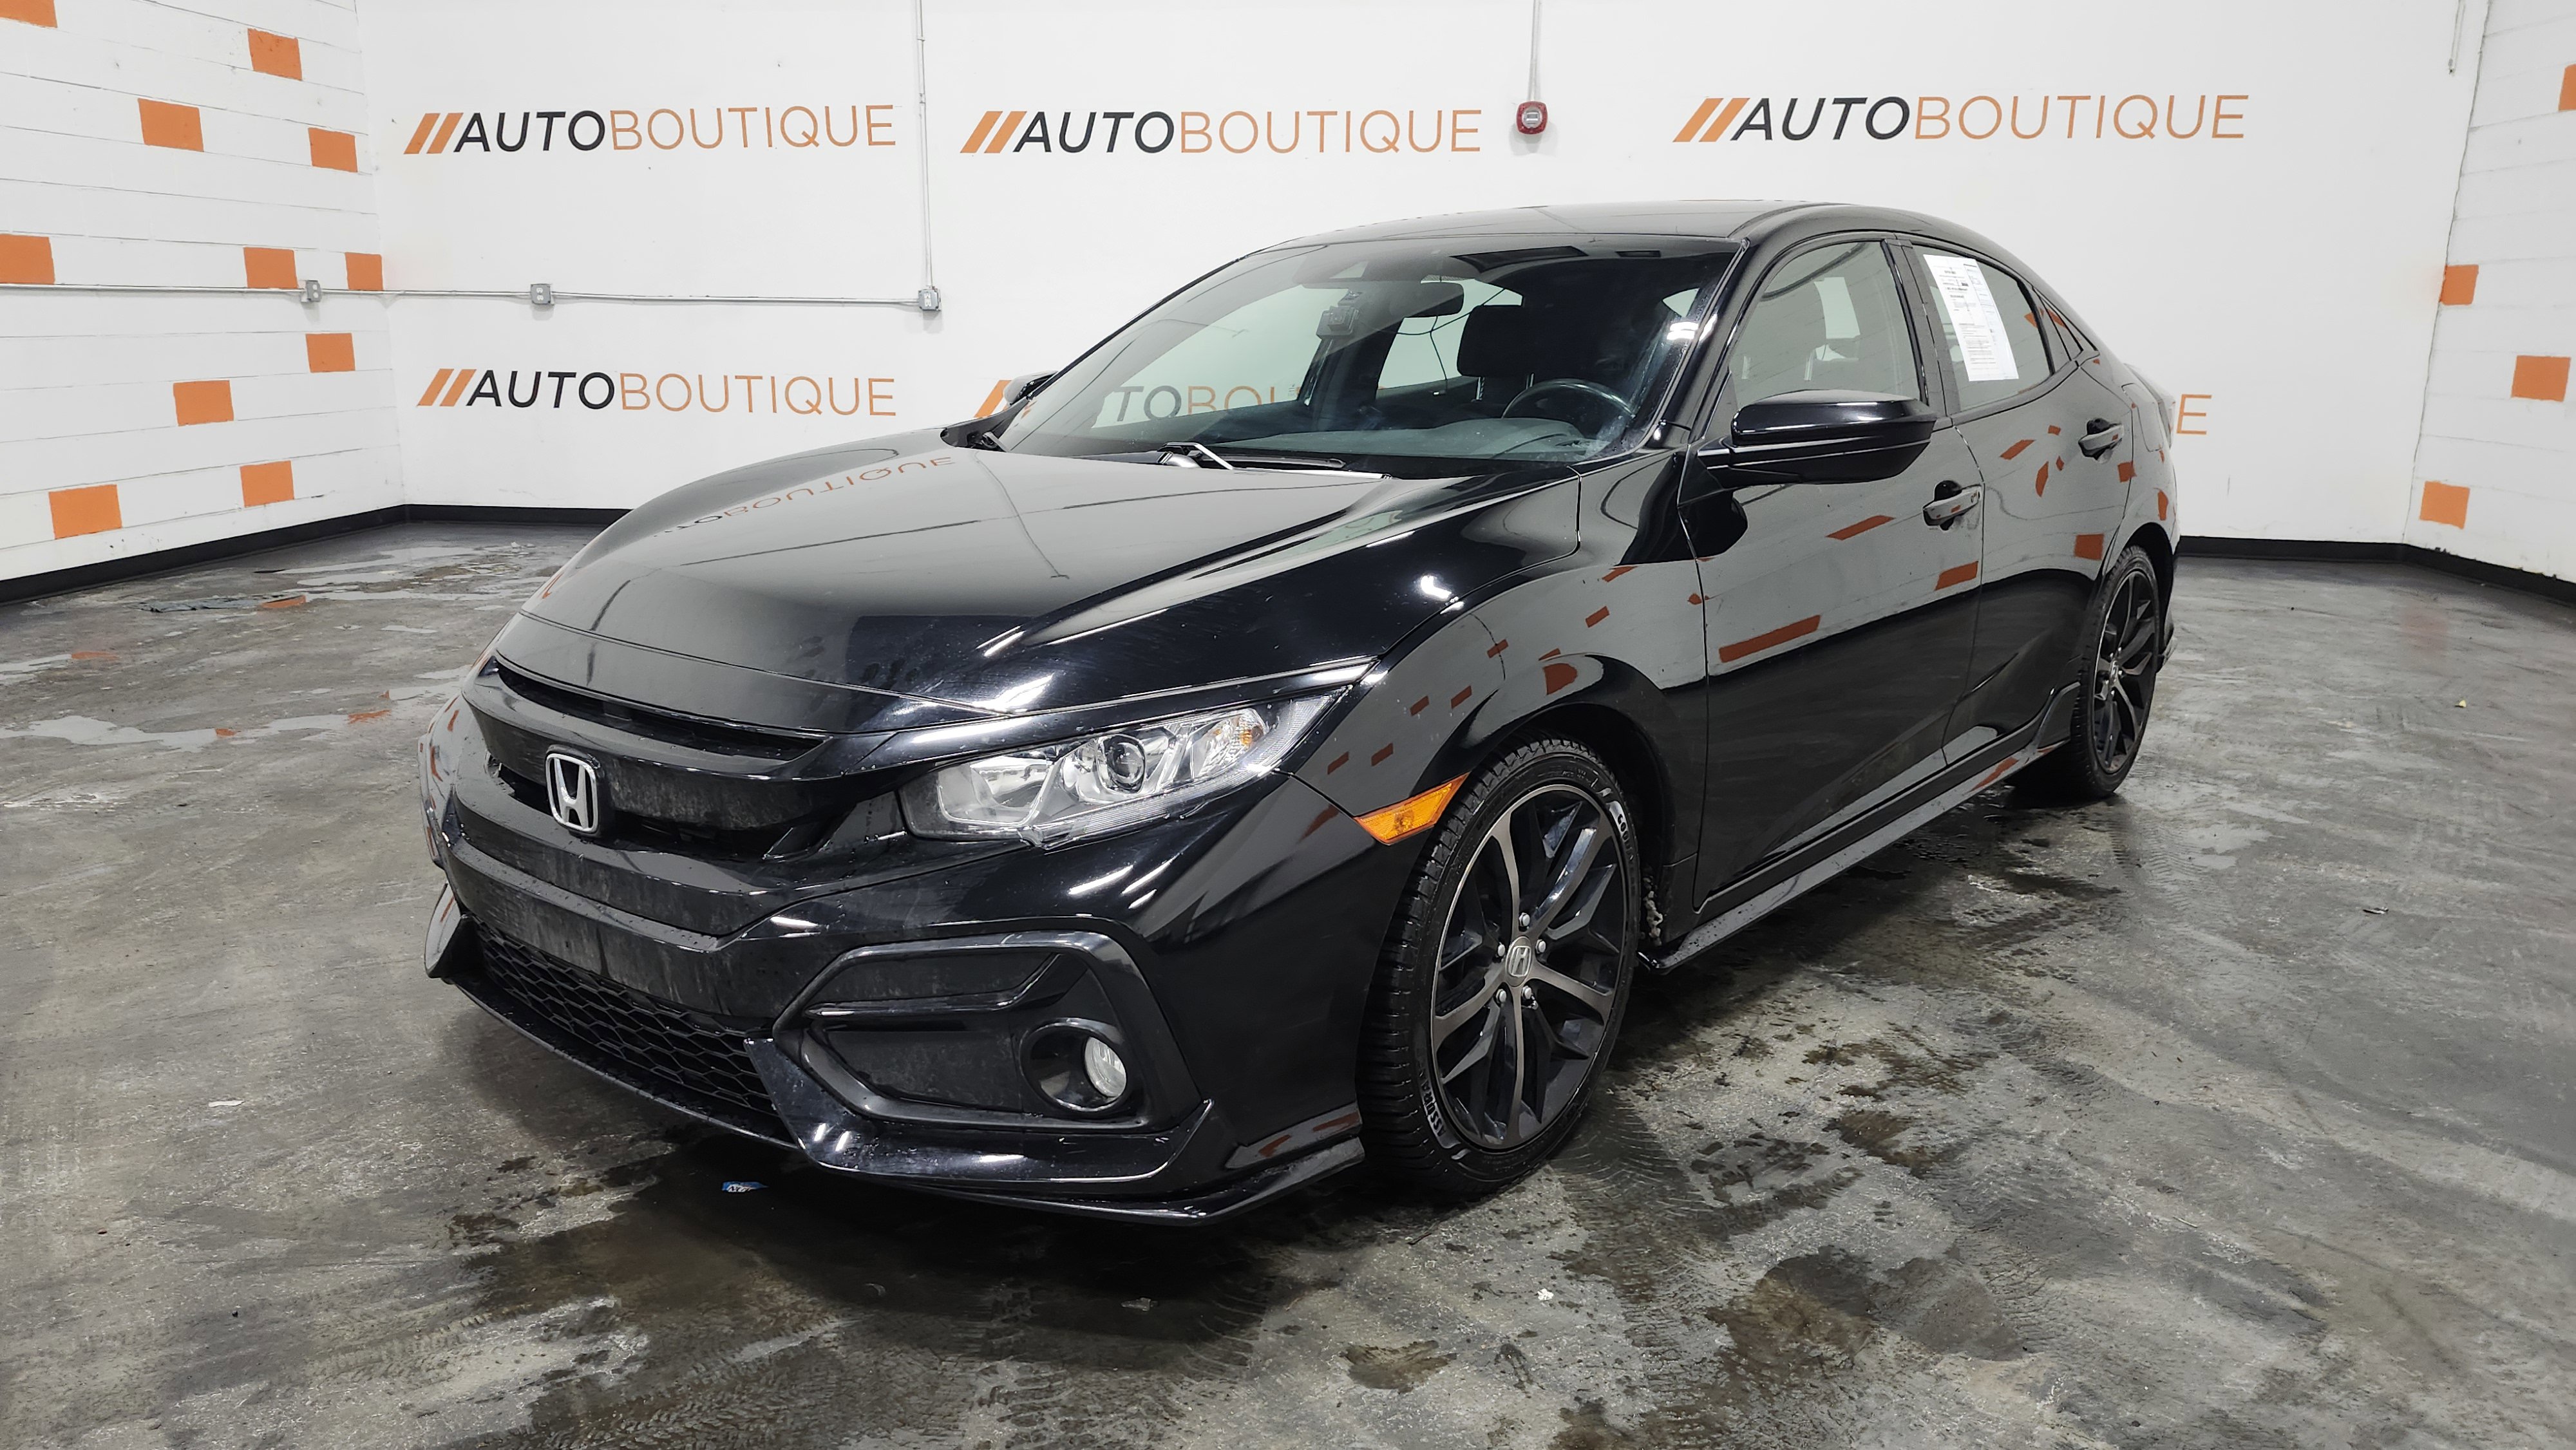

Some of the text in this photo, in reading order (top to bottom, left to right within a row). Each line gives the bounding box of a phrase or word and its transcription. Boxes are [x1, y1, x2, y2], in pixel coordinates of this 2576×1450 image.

[453, 105, 896, 153] AUTOBOUTIQUE
[1013, 110, 1482, 153] AUTOBOUTIQUE
[1730, 95, 2249, 141] AUTOBOUTIQUE
[466, 370, 896, 417] AUTOBOUTIQUE
